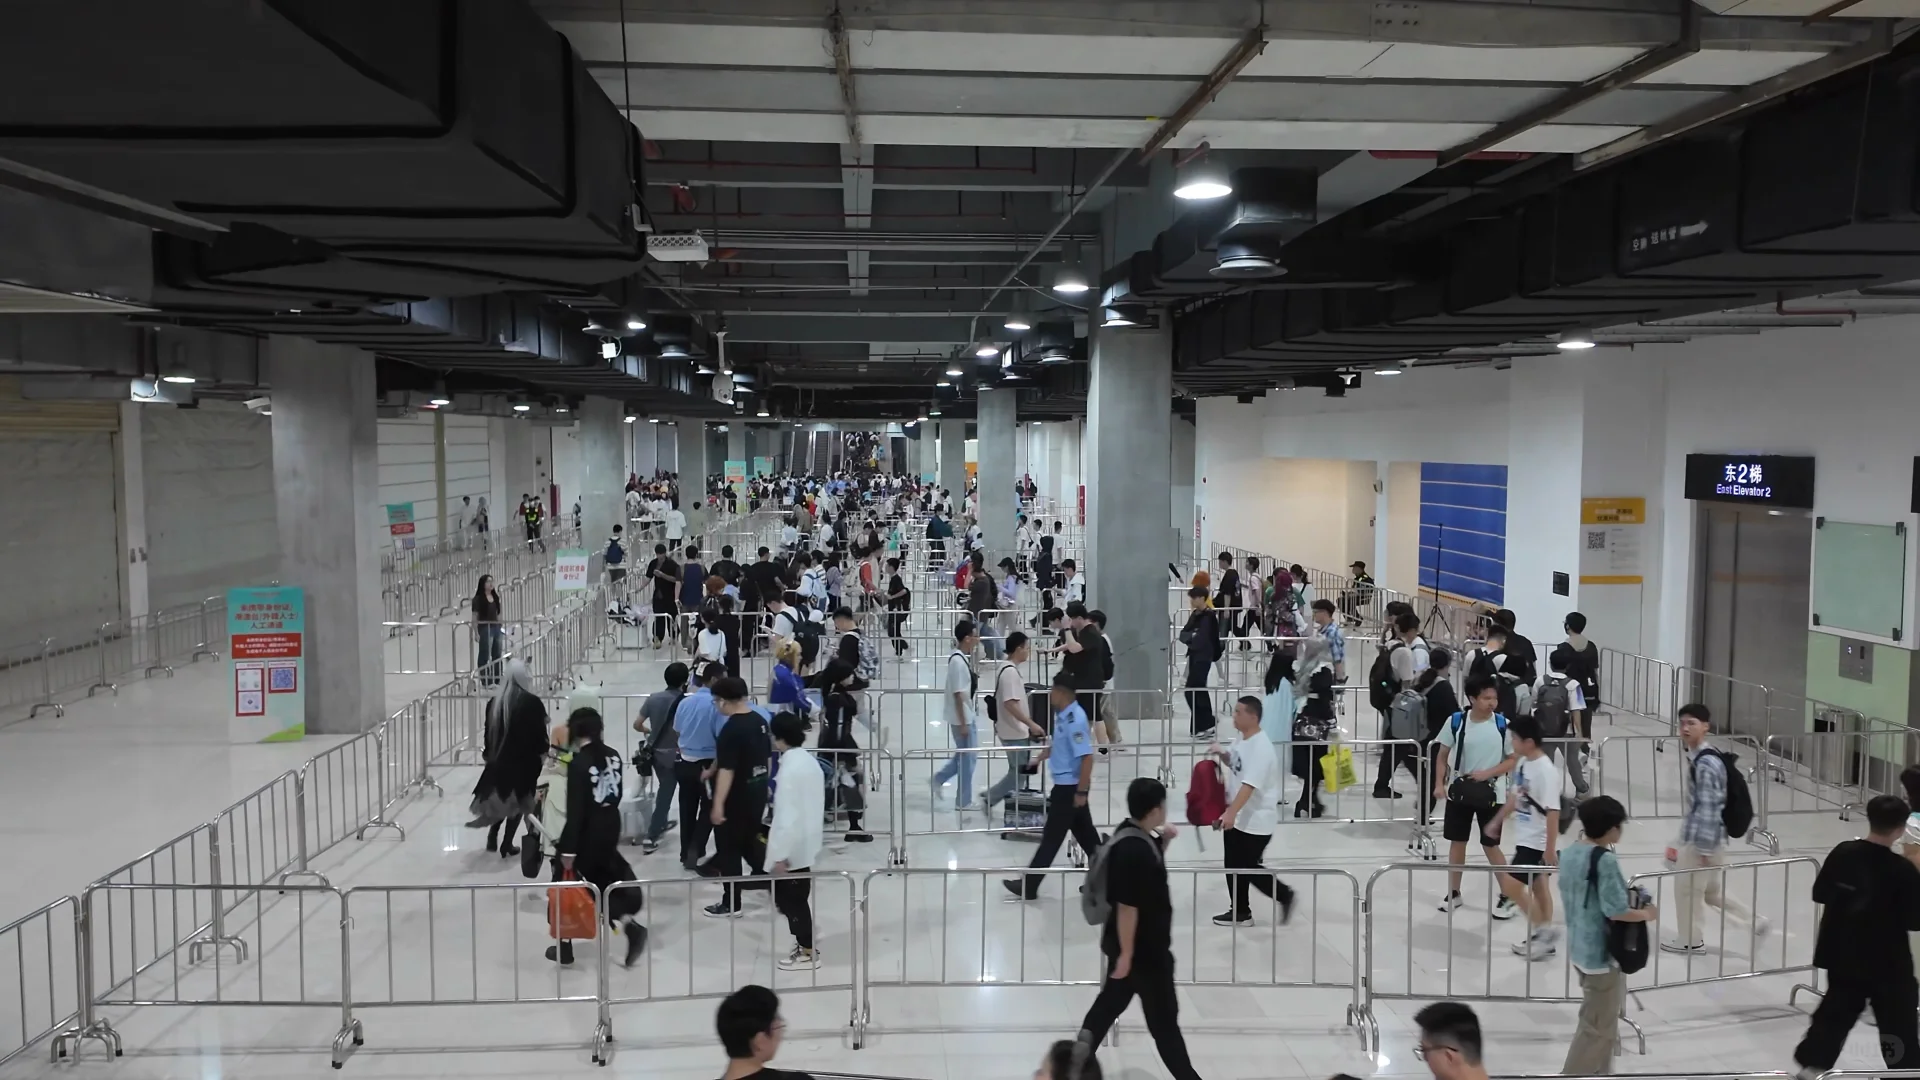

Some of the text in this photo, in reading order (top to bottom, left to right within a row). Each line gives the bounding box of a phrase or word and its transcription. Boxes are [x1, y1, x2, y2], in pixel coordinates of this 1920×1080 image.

[1725, 463, 1762, 484] 东2梯
[1716, 483, 1771, 498] East Elevator 2
